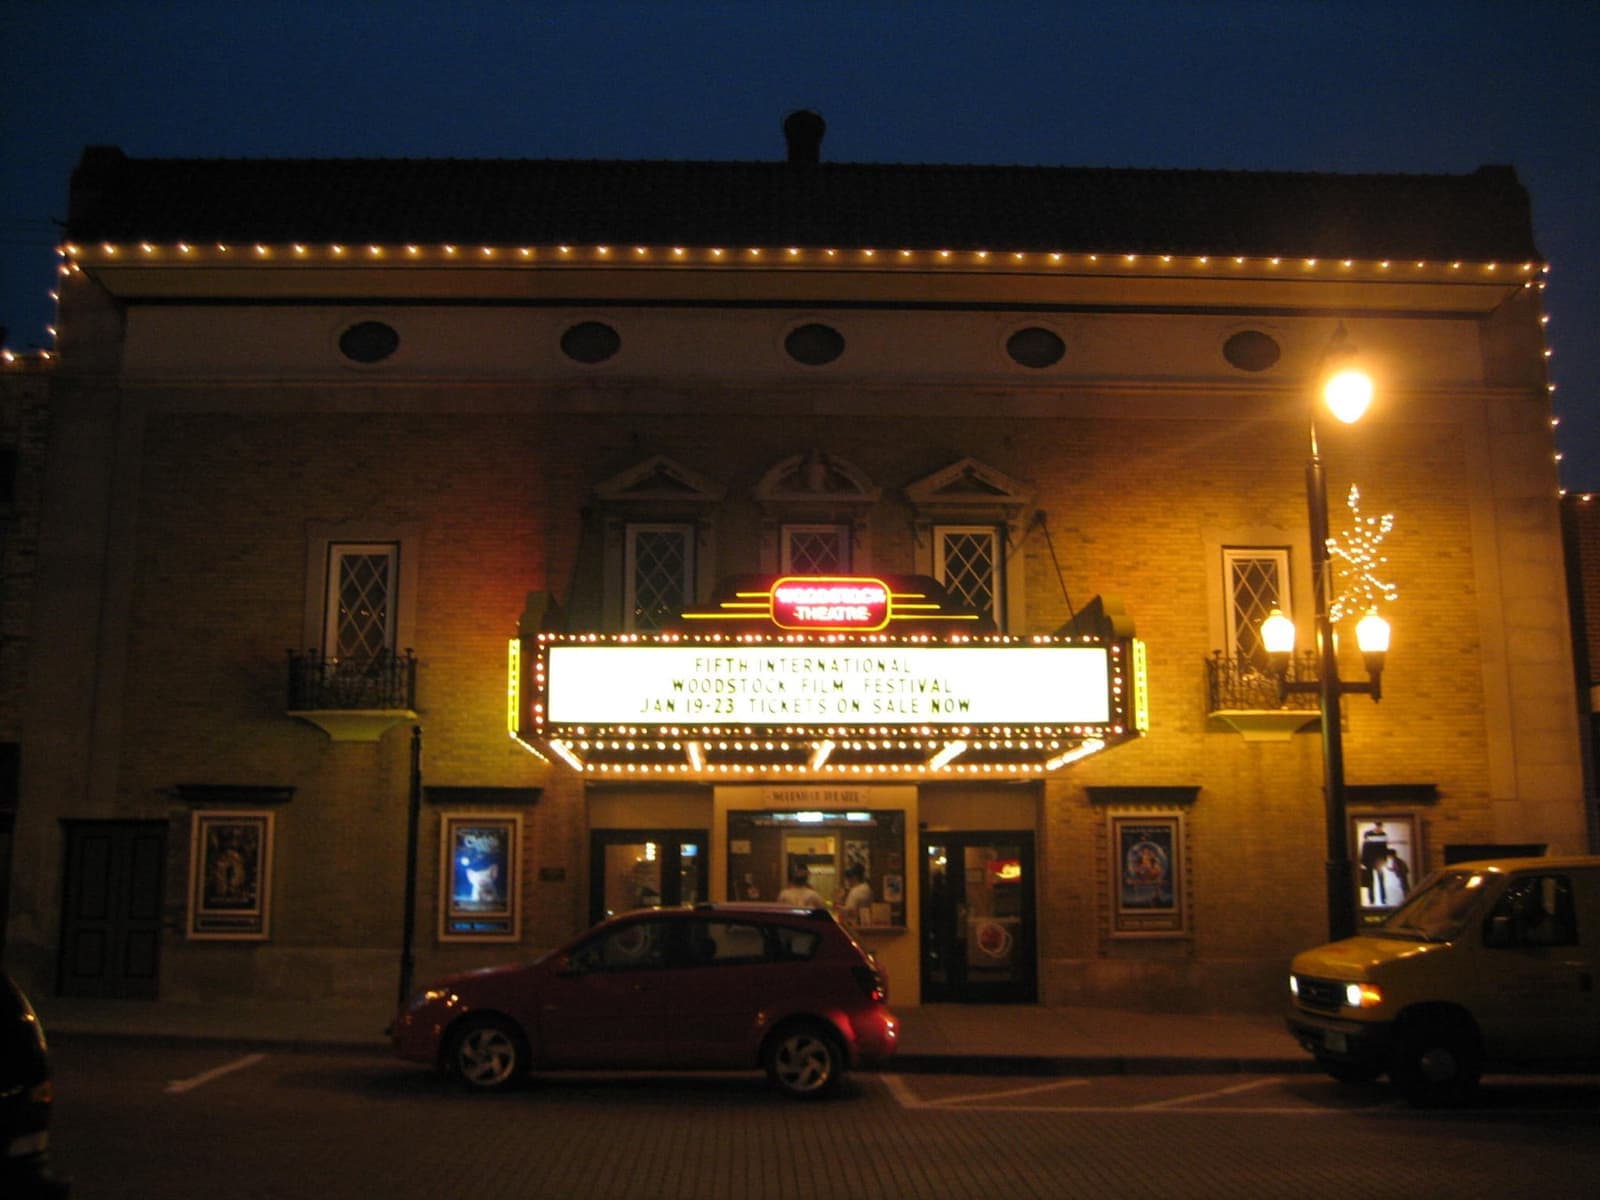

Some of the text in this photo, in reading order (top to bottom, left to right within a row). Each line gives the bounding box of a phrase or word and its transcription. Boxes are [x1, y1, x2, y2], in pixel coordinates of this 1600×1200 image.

[695, 657, 911, 673] FIFTH INTERNATIONAL
[671, 677, 952, 694] WOODSTOCK FILM FESTIVAL
[639, 697, 971, 714] JAN 19-23 TICKETS ON SALE NOW
